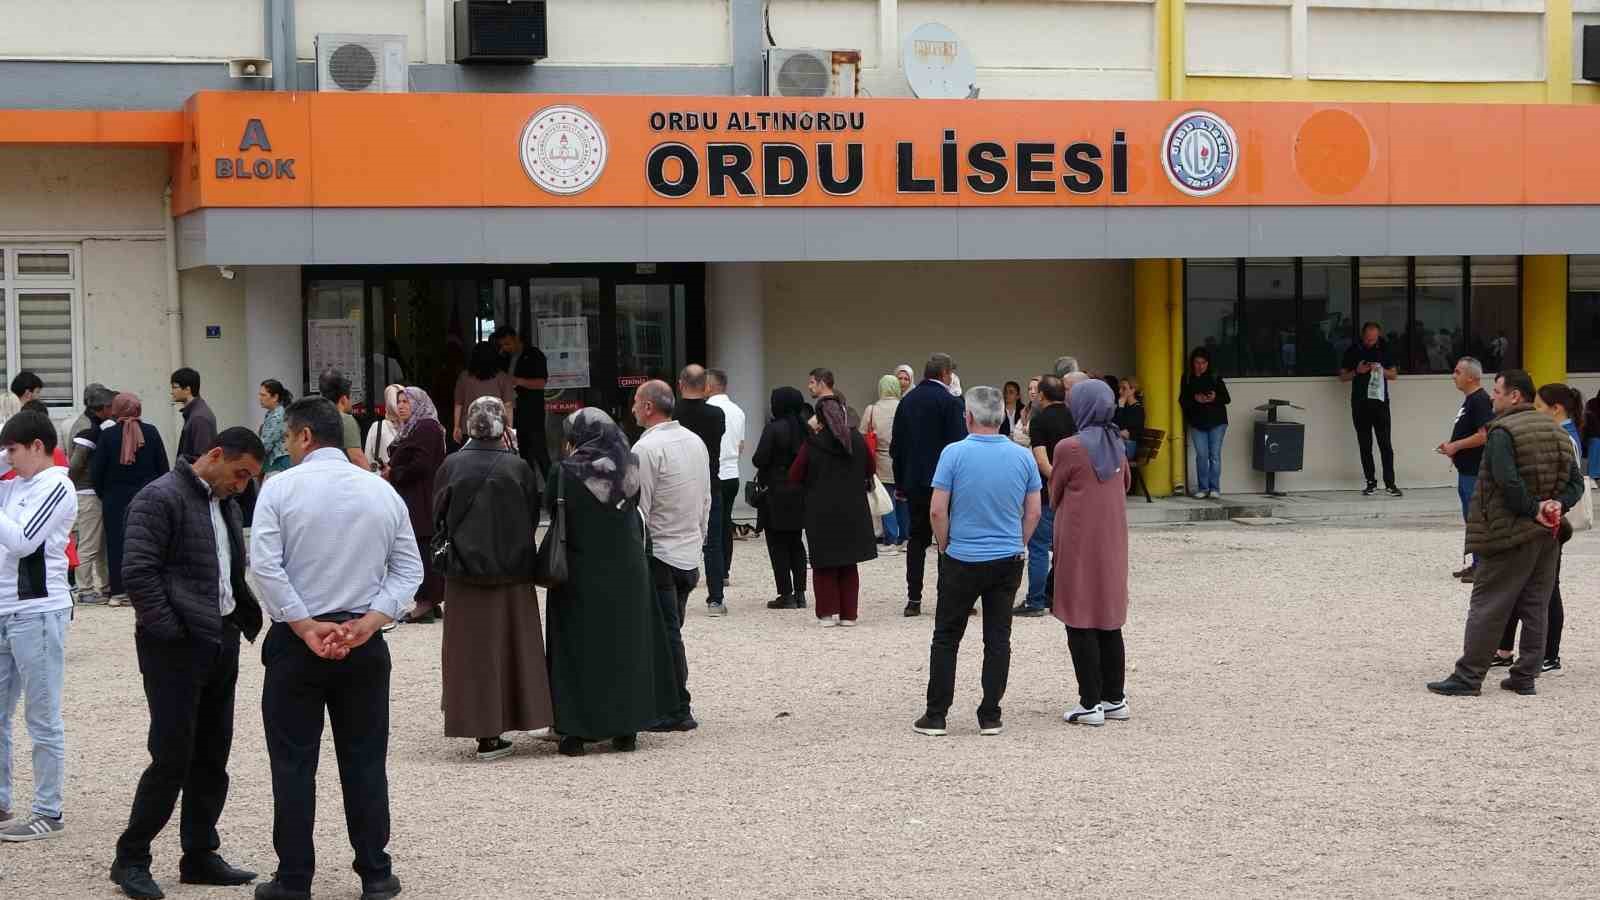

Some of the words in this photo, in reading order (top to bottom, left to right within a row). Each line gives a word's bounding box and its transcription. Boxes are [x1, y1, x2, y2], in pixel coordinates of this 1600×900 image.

[239, 118, 272, 151] A
[650, 111, 718, 131] ORDU
[727, 111, 865, 131] ALTINORDU
[1171, 122, 1195, 153] ORDU
[215, 158, 297, 180] BLOK
[646, 141, 865, 198] ORDU
[895, 127, 1129, 194] LİSESİ
